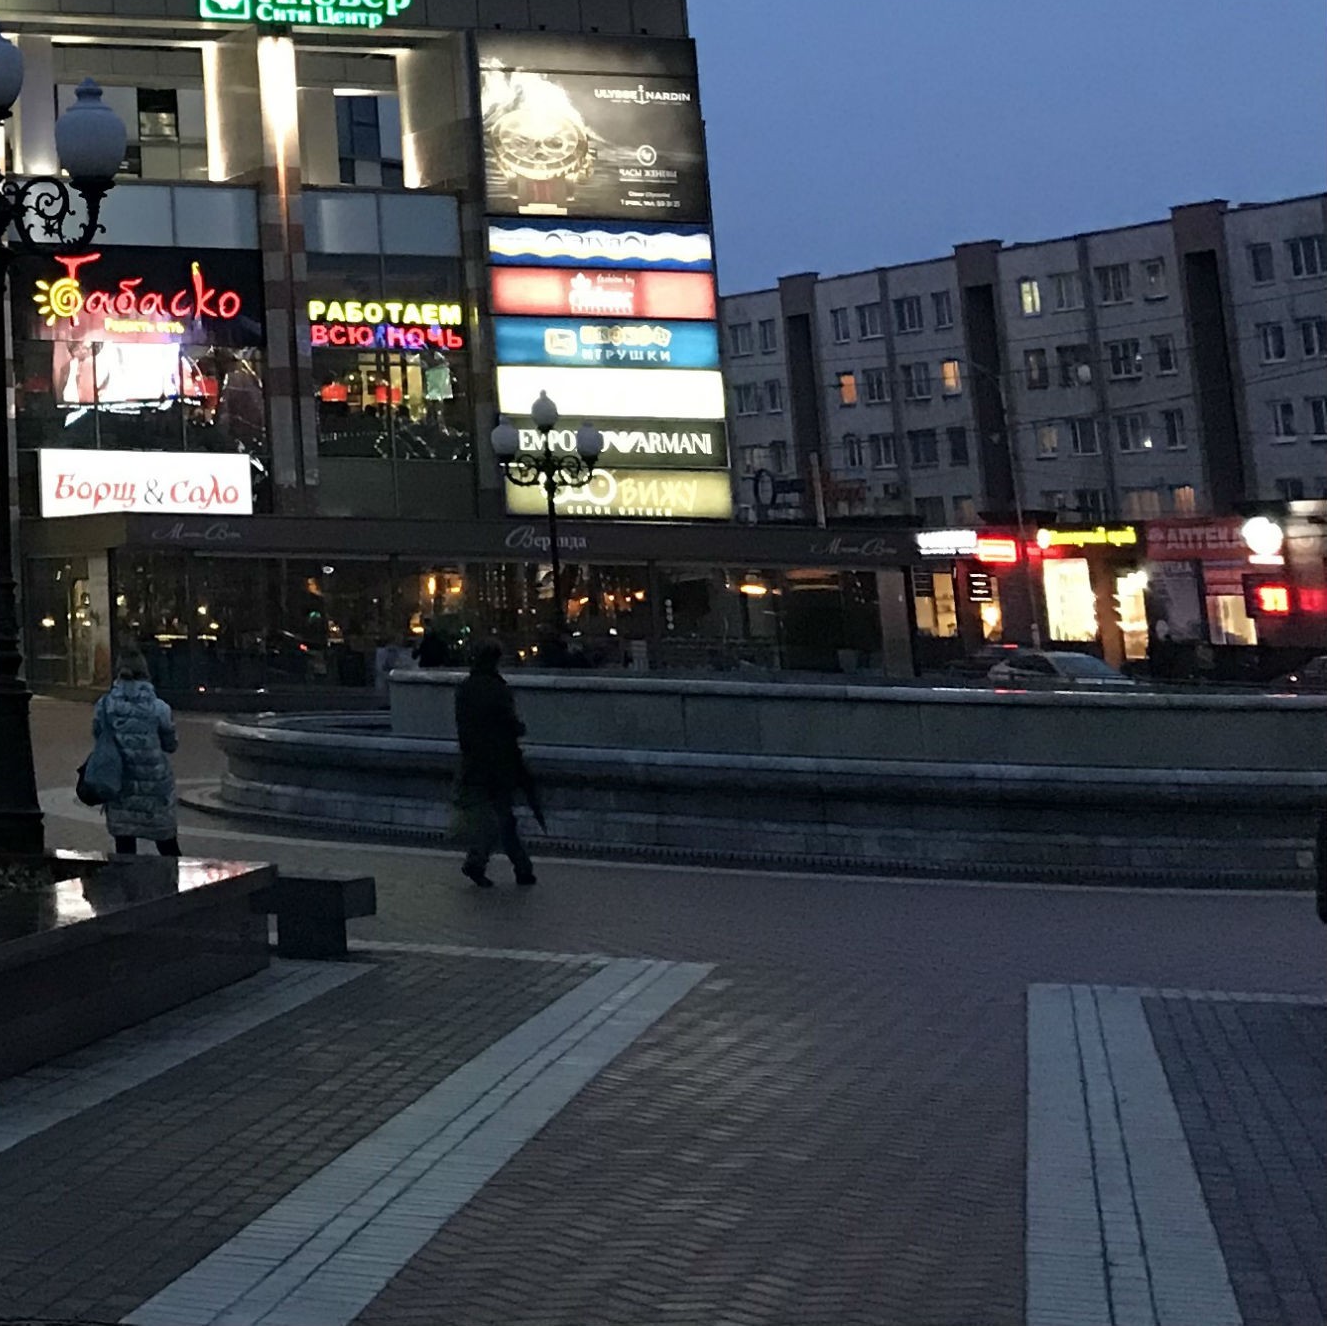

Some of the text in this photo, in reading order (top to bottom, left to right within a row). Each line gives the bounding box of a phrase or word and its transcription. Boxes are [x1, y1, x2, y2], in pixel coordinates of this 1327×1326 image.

[256, 5, 384, 28] Сити Центр
[646, 91, 691, 101] NARDIN
[51, 253, 242, 327] Табаско
[309, 300, 462, 326] РАБОТАЕМ
[311, 324, 463, 349] ВСЮ НОЧЬ
[518, 429, 713, 455] EMPO ARMANI
[55, 473, 239, 510] Борщ & Сало
[505, 527, 588, 551] Вернда
